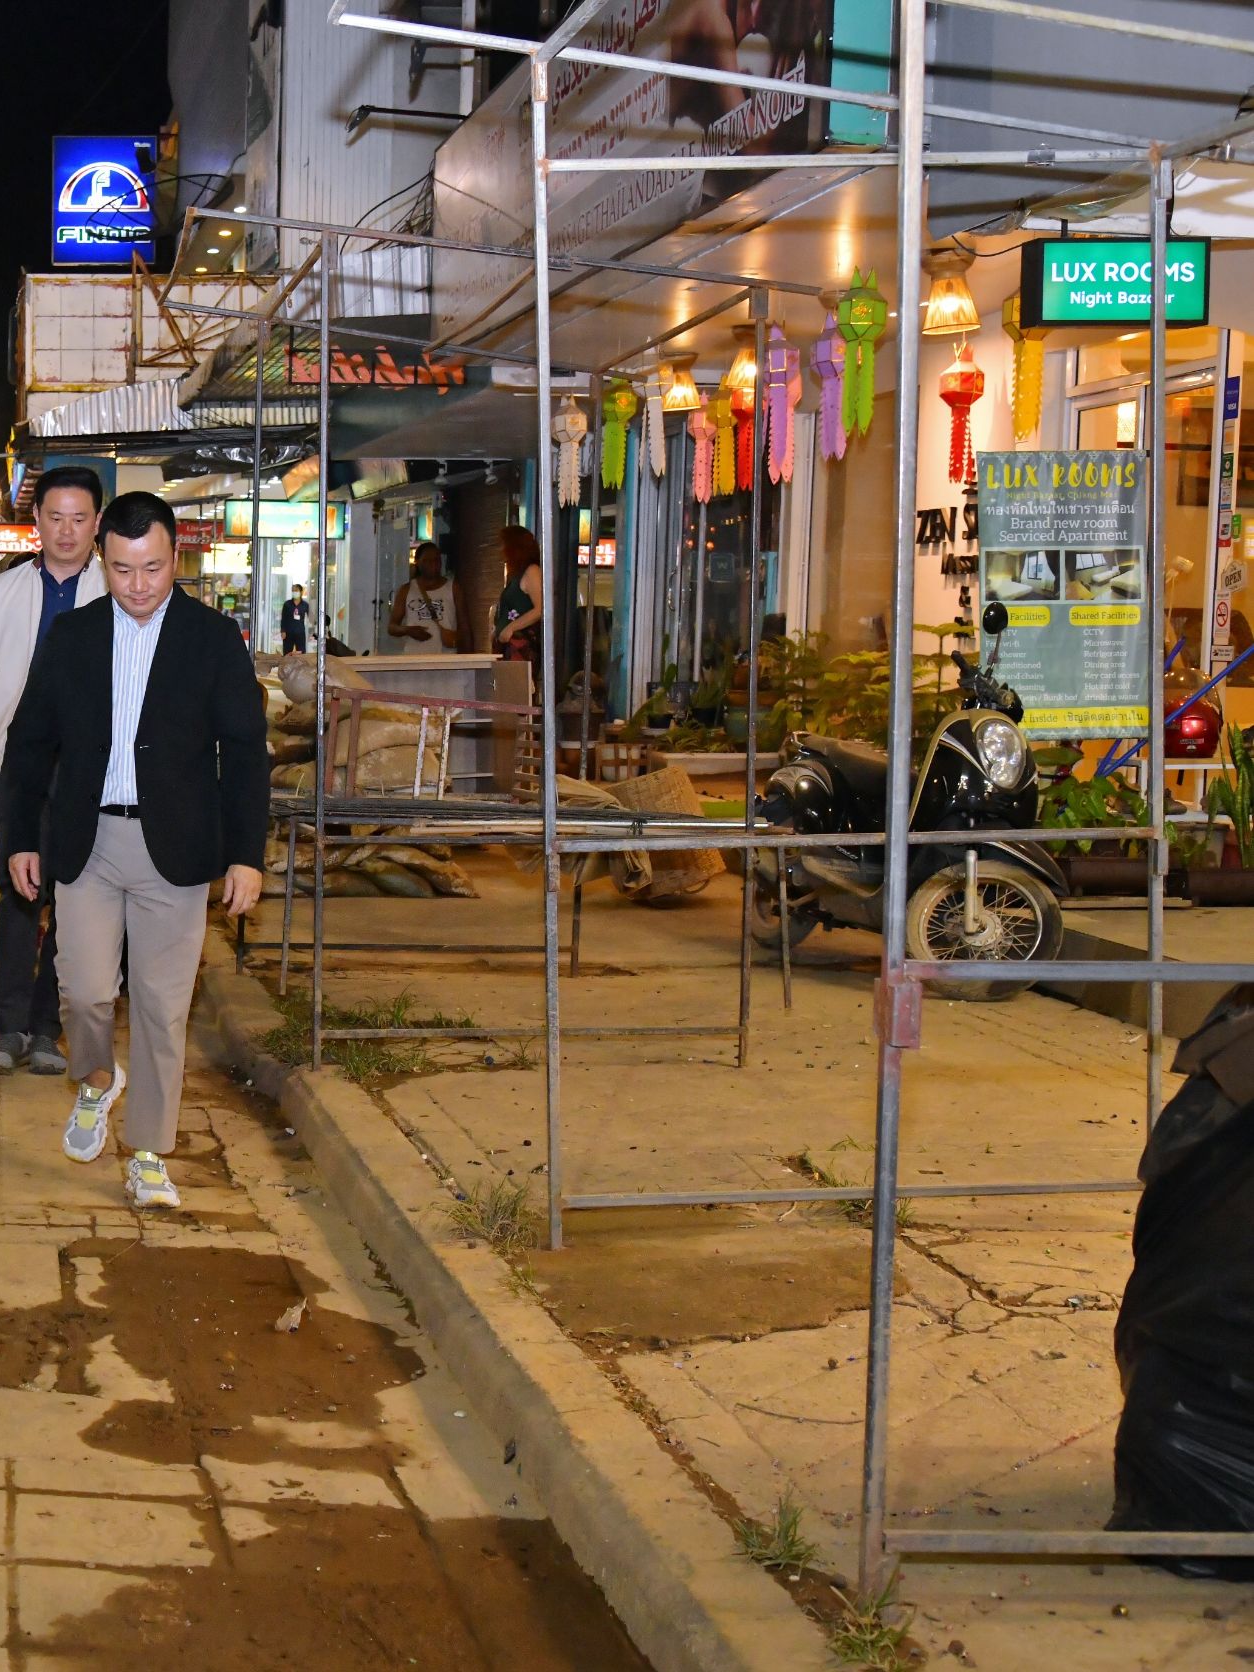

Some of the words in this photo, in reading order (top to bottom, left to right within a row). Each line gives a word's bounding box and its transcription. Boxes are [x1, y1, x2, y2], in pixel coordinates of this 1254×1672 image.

[1051, 262, 1097, 283] LUX
[1070, 291, 1113, 308] Night
[1118, 291, 1175, 304] Bazar
[986, 463, 1039, 490] LUX
[1052, 462, 1135, 489] ROOMS
[1010, 517, 1050, 530] Brand
[1053, 520, 1080, 529] new
[1083, 519, 1118, 529] room
[999, 530, 1055, 543] Serviced
[1058, 529, 1128, 543] Apartment
[1224, 570, 1243, 588] OPEN
[1009, 612, 1047, 621] Facilities
[1071, 611, 1099, 620] Shared
[1101, 610, 1138, 620] Facilities
[1083, 628, 1105, 636] CCTV
[1030, 713, 1058, 724] inside
